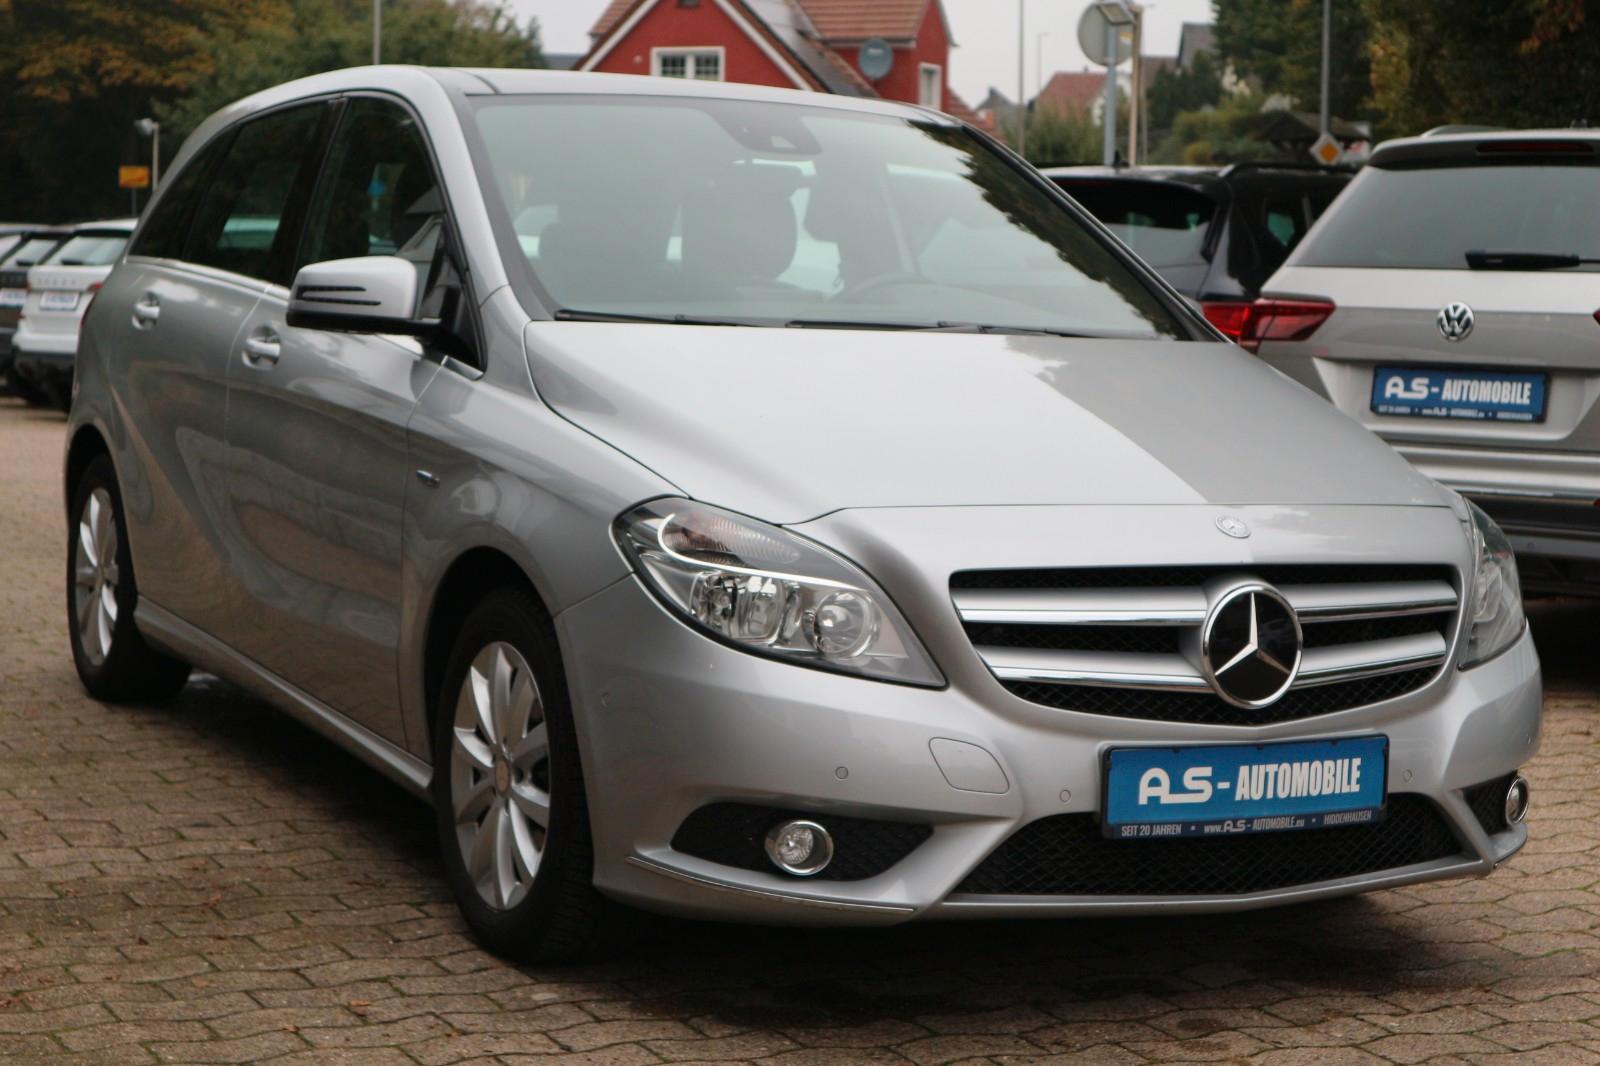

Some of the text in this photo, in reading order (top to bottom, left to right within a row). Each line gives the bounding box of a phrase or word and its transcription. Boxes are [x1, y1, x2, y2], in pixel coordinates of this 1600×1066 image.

[1440, 302, 1472, 338] VW
[1121, 825, 1138, 837] SEIT
[1139, 825, 1151, 836] 20
[1151, 823, 1182, 835] JAHREN
[1323, 809, 1372, 825] HIDDENHAUSEN
